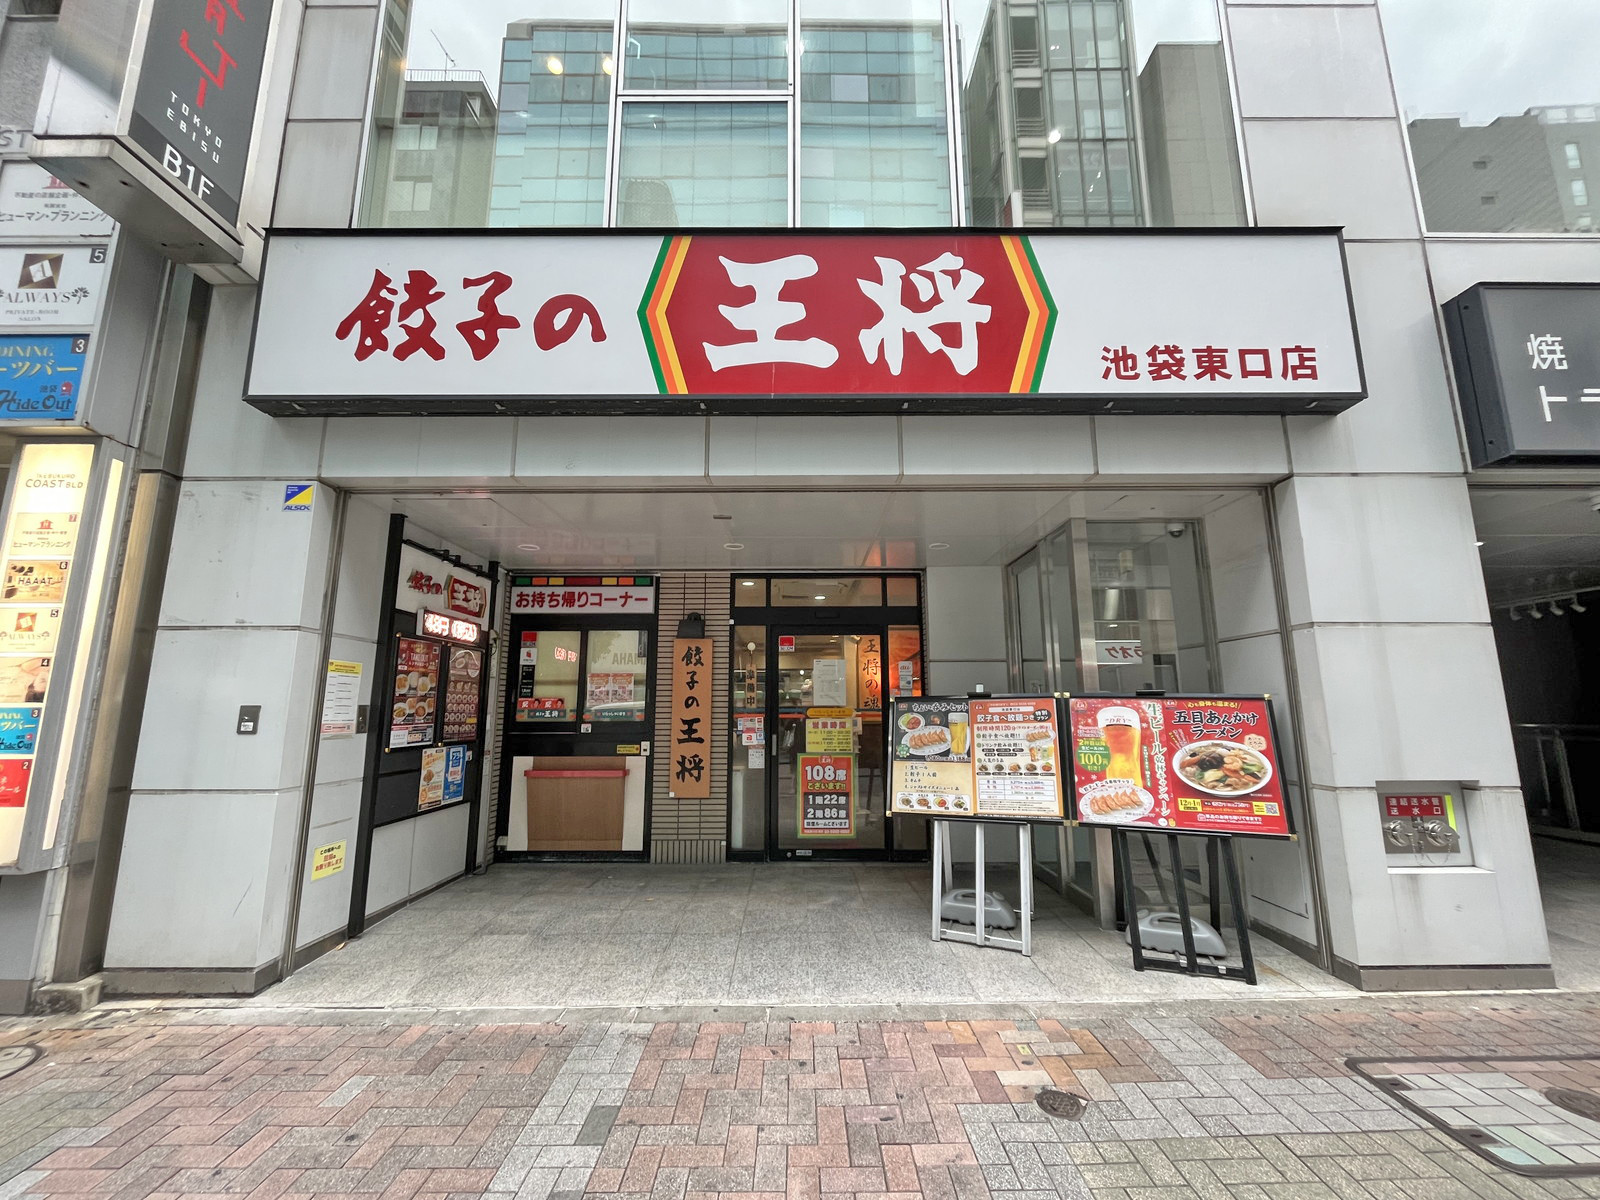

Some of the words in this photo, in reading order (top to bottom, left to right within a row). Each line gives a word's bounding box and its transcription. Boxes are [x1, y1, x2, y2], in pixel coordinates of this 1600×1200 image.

[170, 91, 222, 148] TOKYO
[166, 107, 220, 164] EBISU
[162, 144, 215, 200] B1F
[93, 249, 105, 263] 5
[4, 291, 71, 303] ALWAYS
[336, 268, 607, 362] 餃子の
[702, 252, 992, 376] 王将
[75, 339, 85, 353] 3
[1526, 334, 1568, 369] 焼
[1101, 344, 1319, 381] 池袋東口店
[42, 394, 73, 410] Out
[26, 478, 64, 488] COAST
[407, 568, 443, 595] 餃子の
[452, 582, 481, 613] 王将
[515, 591, 648, 608] お持ち帰りコーナー
[42, 659, 49, 667] 4
[675, 645, 706, 784] 餃子の王将
[1173, 709, 1259, 726] 五目あんかけ
[1191, 725, 1242, 739] ラーメン
[1390, 806, 1441, 815] 送水口
